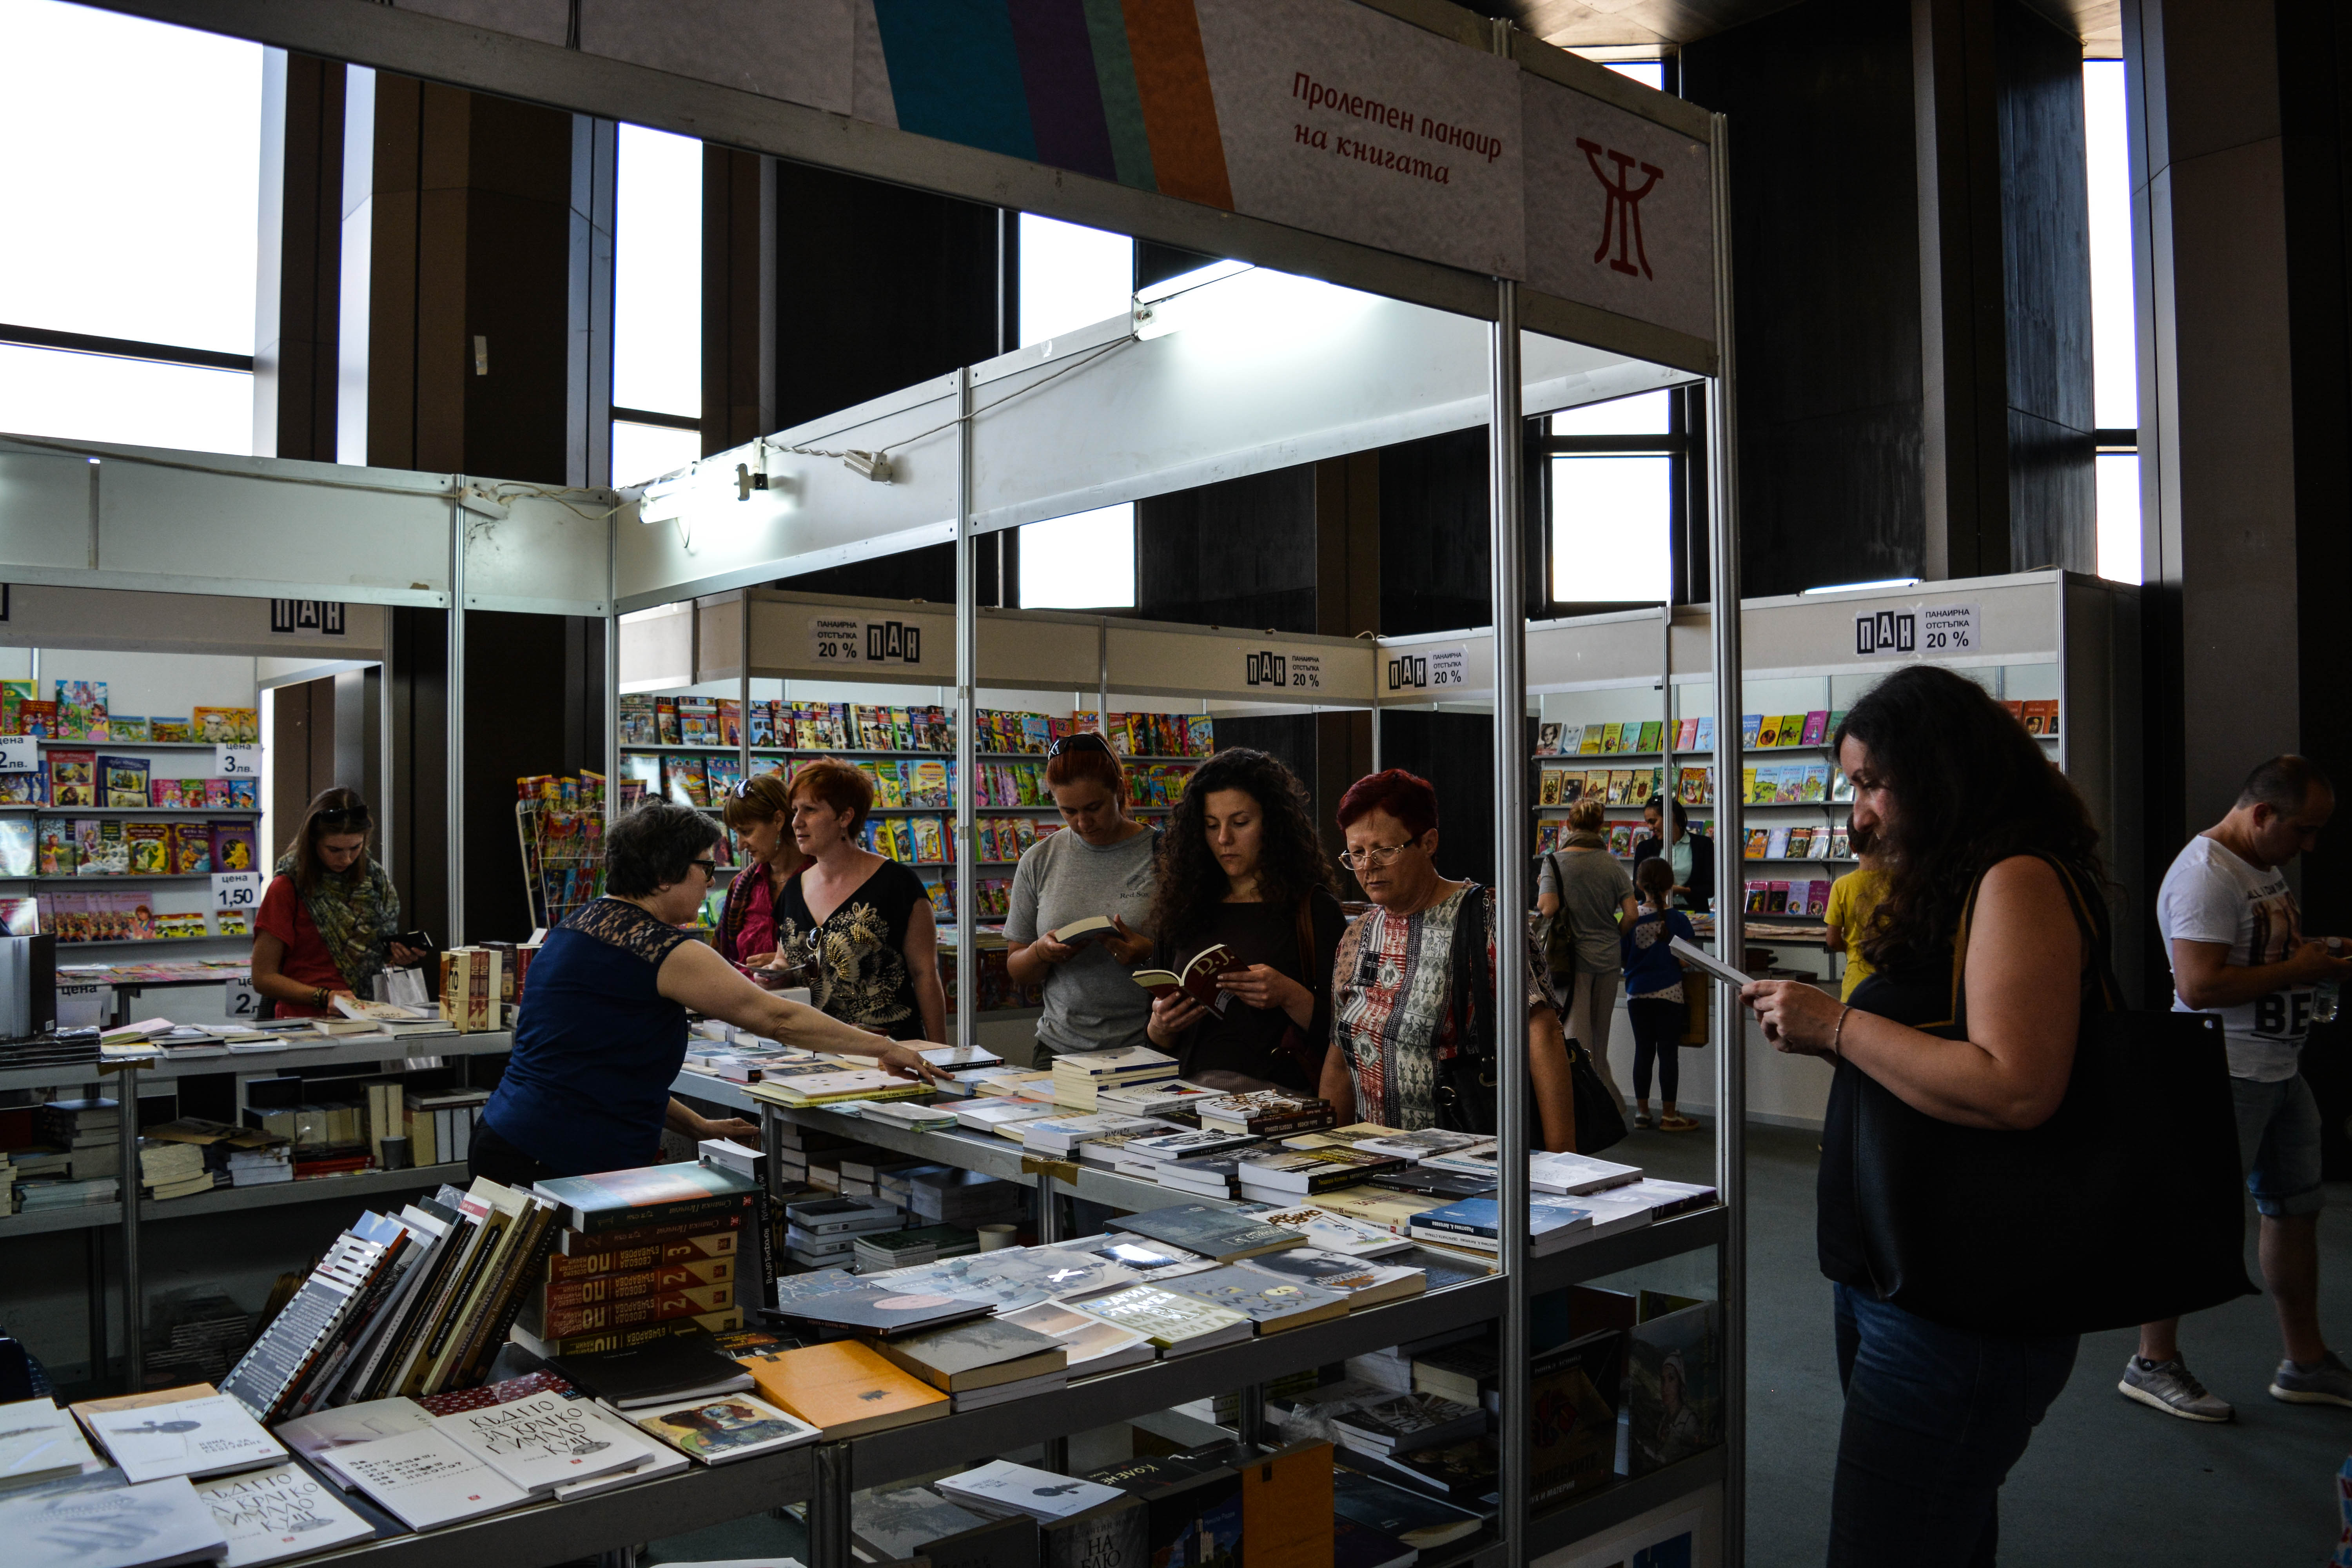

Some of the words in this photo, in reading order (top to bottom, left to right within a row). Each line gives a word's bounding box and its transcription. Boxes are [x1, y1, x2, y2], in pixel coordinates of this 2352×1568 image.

[1293, 72, 1414, 132] Пролетен
[1421, 118, 1501, 163] панаир
[1294, 123, 1327, 150] на
[1336, 136, 1450, 185] книгата
[272, 599, 345, 635] ПАН
[1926, 619, 1969, 630] ОТСТЪПКА
[817, 632, 857, 640] ОТСТЪПКА
[1856, 611, 1915, 654] ПАН
[1926, 632, 1947, 649] 20
[1952, 631, 1969, 648] %
[818, 642, 837, 658] 20
[843, 643, 857, 658] %
[867, 621, 920, 663] ПАН
[1247, 651, 1286, 687] ПАН
[1388, 655, 1426, 690] ПАН
[1434, 671, 1447, 684] 20
[1450, 670, 1462, 683] %
[1292, 673, 1307, 687] 20
[1309, 674, 1320, 687] %
[222, 873, 248, 883] цена
[218, 888, 253, 907] 1,50
[1432, 1221, 1450, 1229] Ангелова
[1454, 1225, 1474, 1233] Радостина
[620, 1245, 659, 1259] БЪЧВАРОВА
[668, 1246, 691, 1256] 3
[587, 1253, 610, 1274] ПО
[620, 1256, 651, 1269] СВОБОДА
[563, 1269, 587, 1278] ОСОБЕНО
[615, 1272, 655, 1288] БЪЧВАРОВА
[662, 1272, 687, 1285] 2
[582, 1280, 605, 1303] ПО
[615, 1283, 647, 1298] СВОБОДА
[473, 1313, 497, 1351] Любомир
[507, 1249, 529, 1284] Любовна
[558, 1297, 583, 1306] ОСОБЕНО
[615, 1298, 655, 1314] БЪЧВАРОВА
[662, 1298, 687, 1311] 2
[582, 1307, 605, 1330] ПО
[615, 1310, 647, 1324] СВОБОДА
[558, 1324, 583, 1333] ОСОБЕНО
[627, 1327, 666, 1343] БЪЧВАРОВА
[675, 1327, 697, 1337] 1
[431, 1338, 441, 1355] ДОБРИ
[439, 1322, 450, 1339] ЖОТЕВ
[594, 1336, 617, 1352] ПО
[469, 1401, 554, 1428] КЪДЕТО
[507, 1423, 585, 1449] ИМАЛО
[1546, 1480, 1575, 1497] МАТЕРИЯ
[1088, 1534, 1113, 1556] НА
